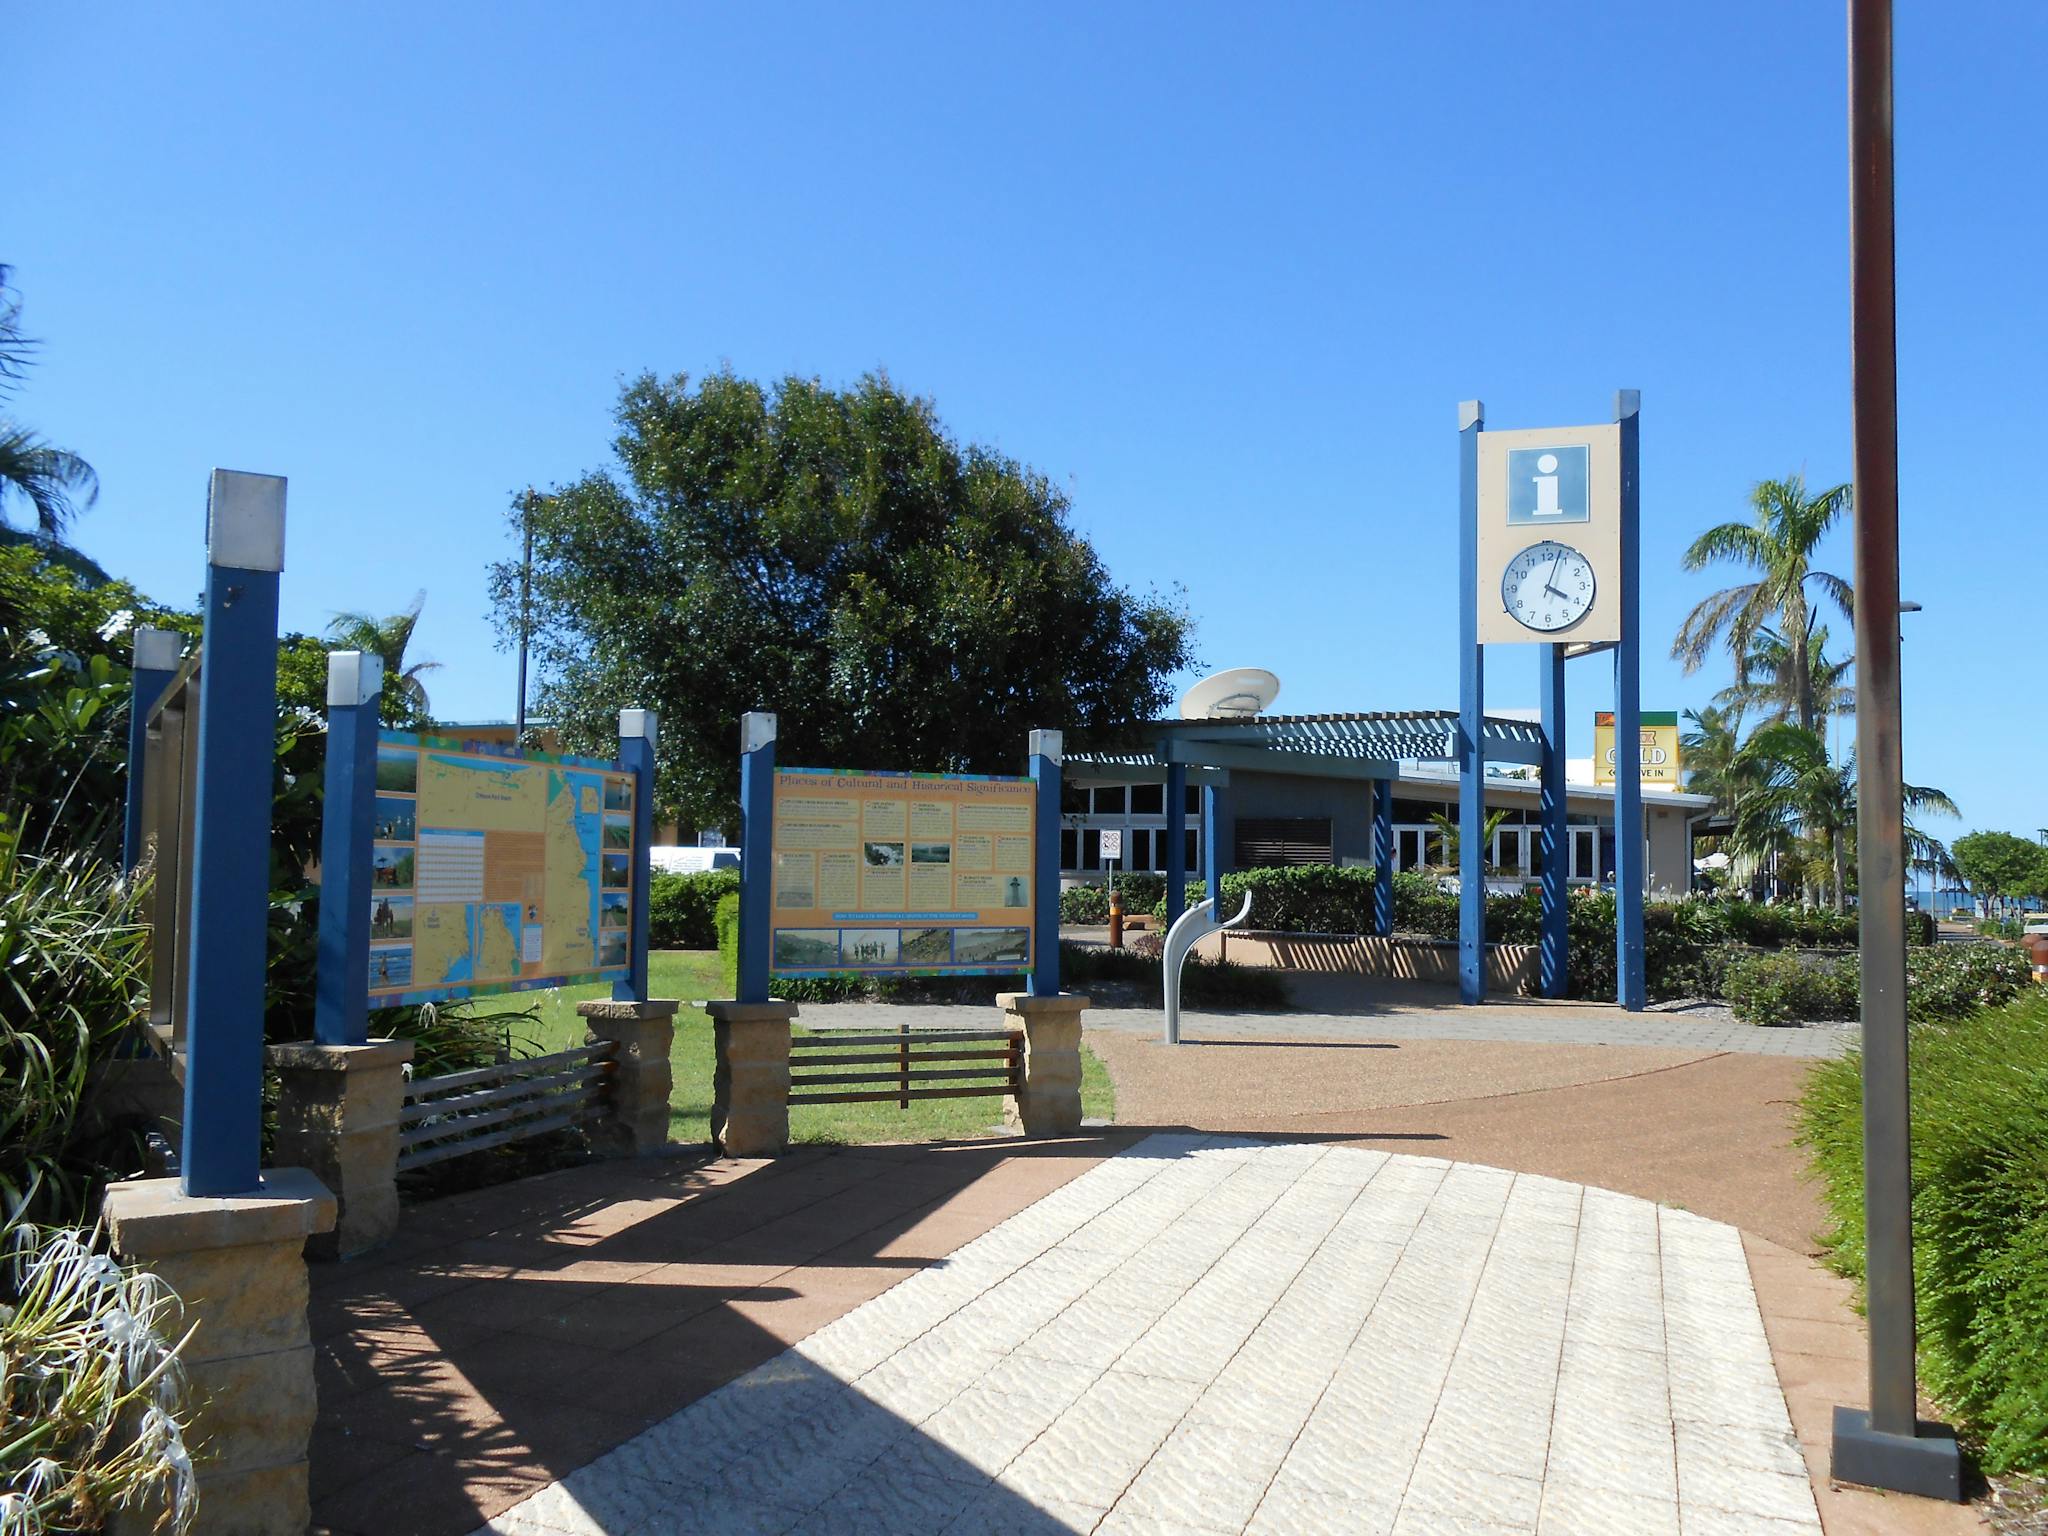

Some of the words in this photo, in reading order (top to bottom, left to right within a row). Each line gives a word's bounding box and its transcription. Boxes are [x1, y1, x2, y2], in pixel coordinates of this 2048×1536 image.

[1541, 553, 1554, 561] 12
[1563, 557, 1568, 566] 1
[1526, 558, 1535, 567] 11
[1515, 571, 1527, 580] 10
[1574, 568, 1580, 577] 2
[1510, 584, 1518, 593] 9
[1580, 582, 1586, 590] 3
[1516, 600, 1523, 608] 8
[1573, 597, 1580, 605] 4
[1530, 611, 1536, 620] 7
[1544, 614, 1552, 622] 6
[1562, 610, 1568, 618] 5
[1605, 747, 1666, 764] GLD
[821, 776, 834, 787] of
[837, 778, 882, 789] Cultural
[887, 780, 907, 789] and
[912, 780, 963, 792] Historical
[967, 782, 1031, 796] Significance
